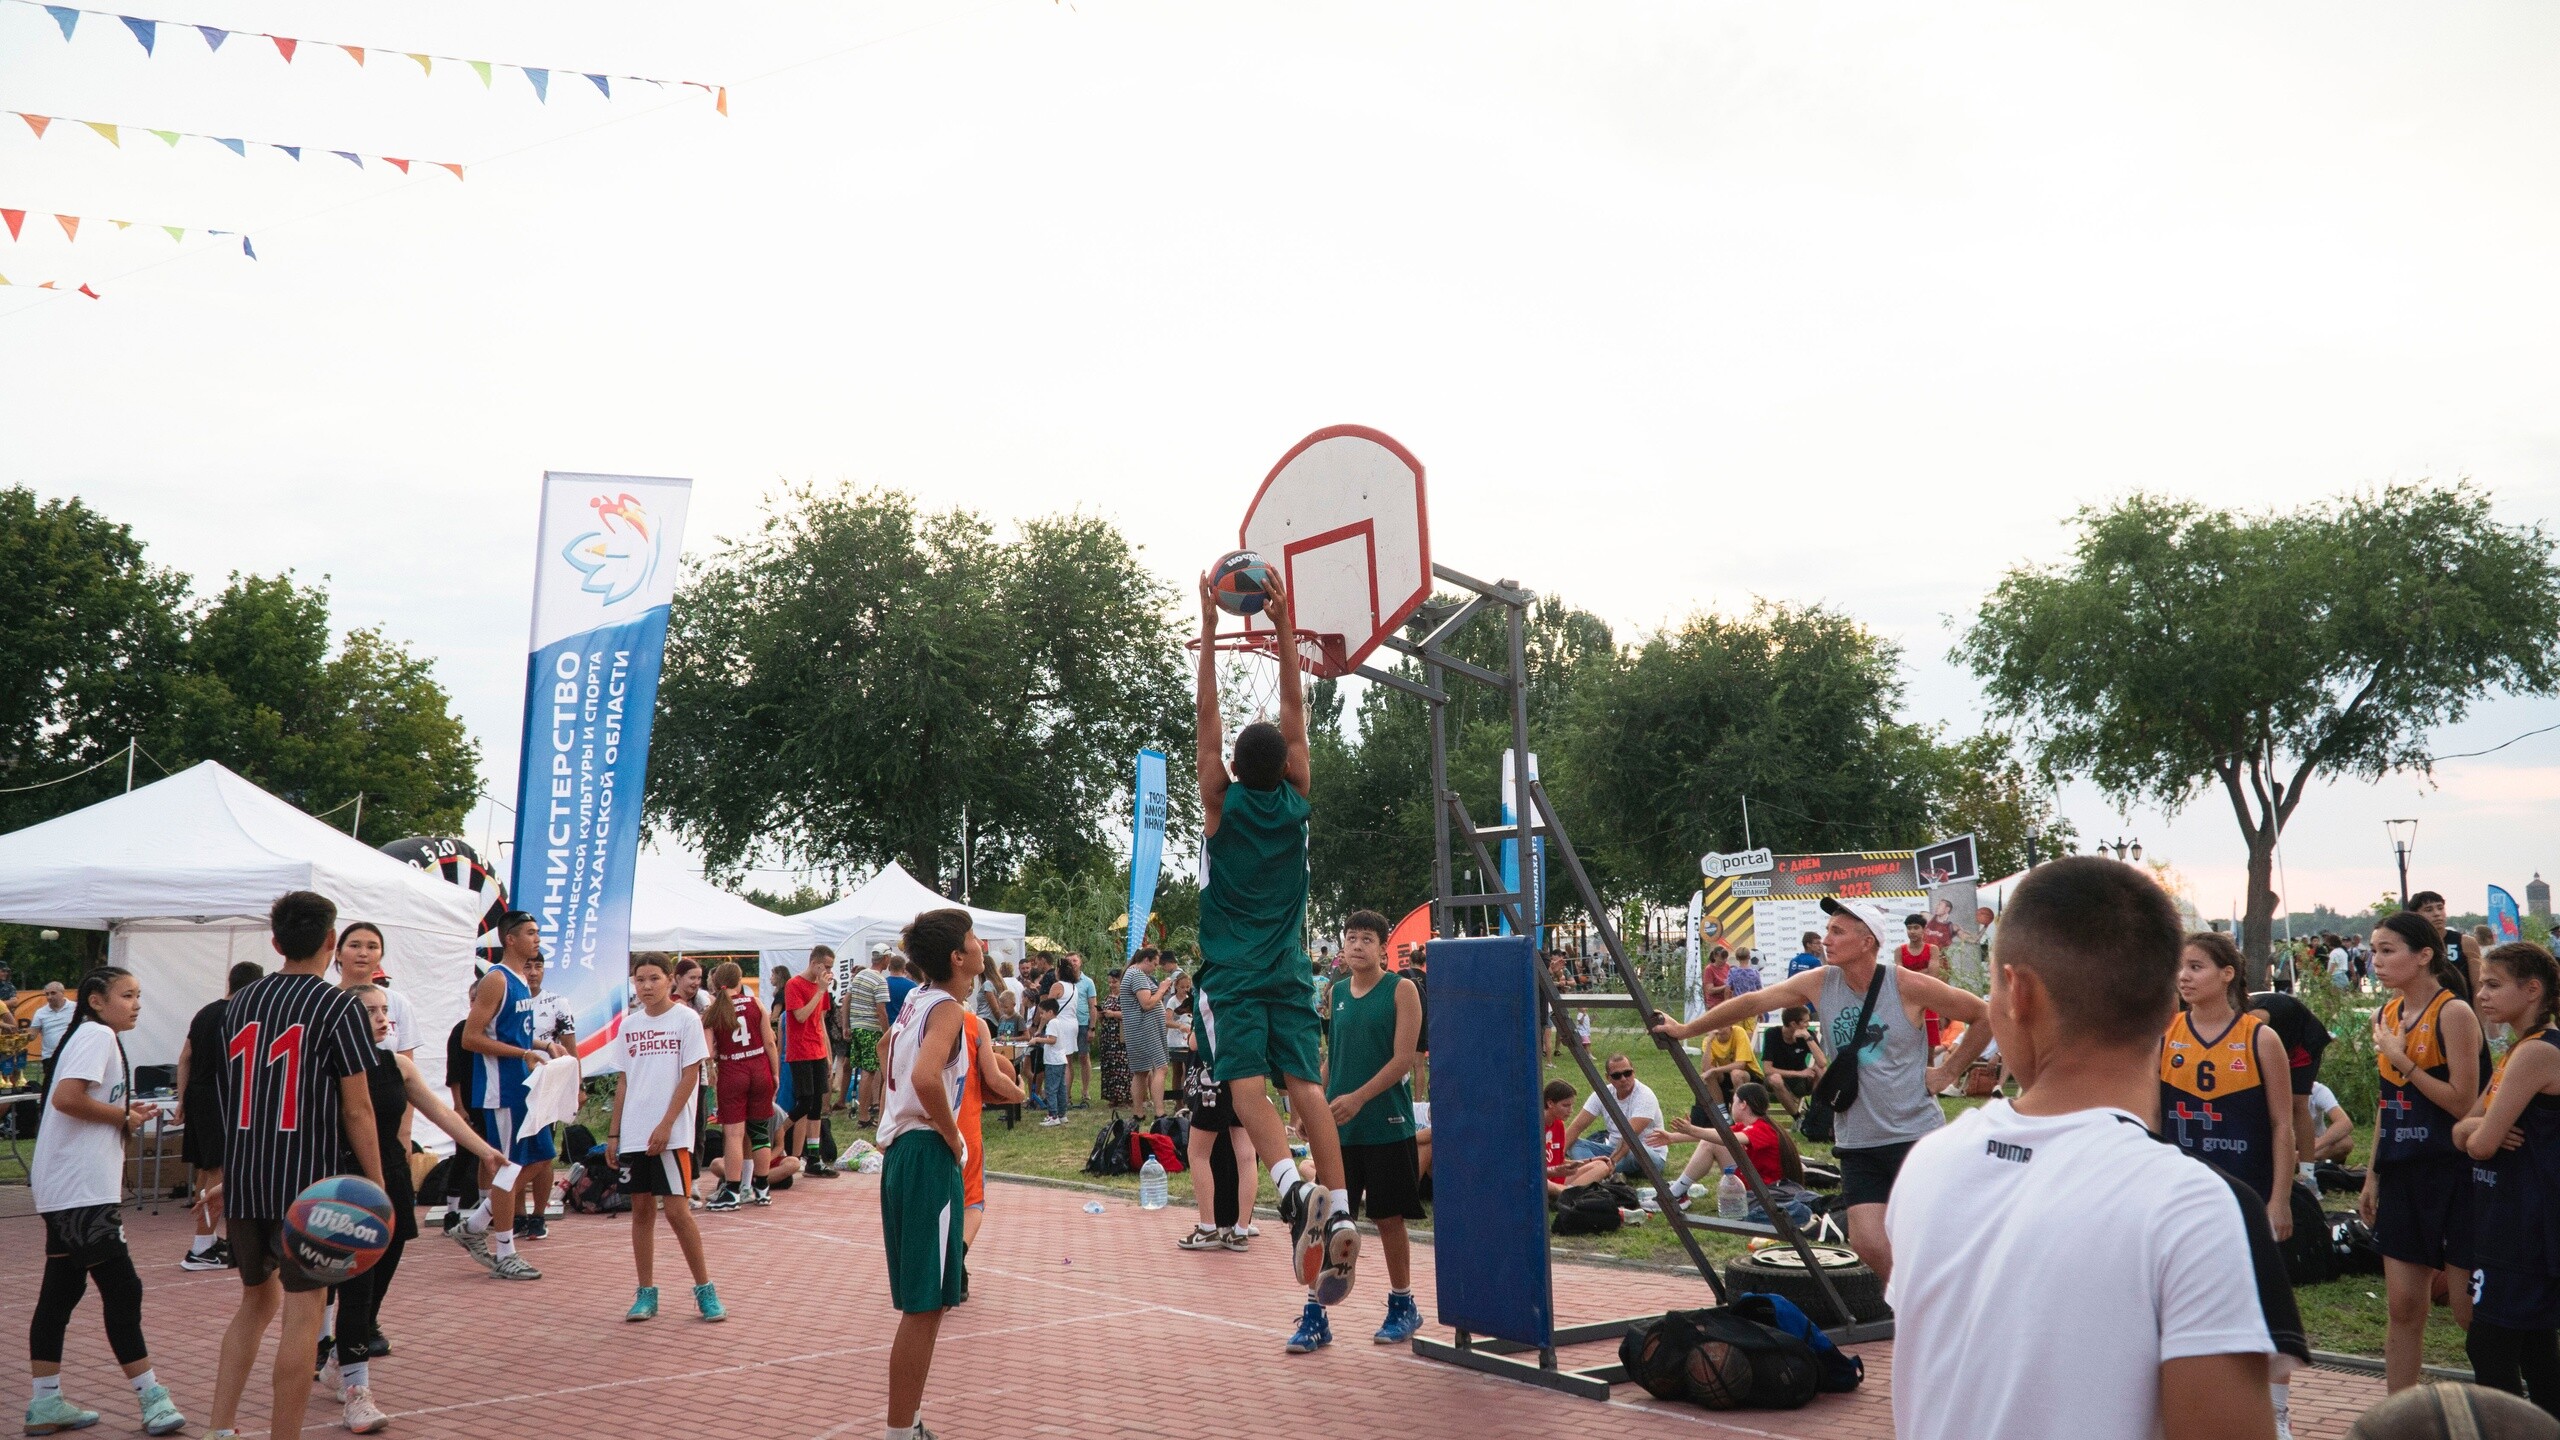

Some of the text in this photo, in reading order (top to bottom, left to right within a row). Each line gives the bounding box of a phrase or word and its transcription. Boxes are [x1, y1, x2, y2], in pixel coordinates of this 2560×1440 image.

[540, 651, 581, 969] МИНИСТЕРСТВО
[562, 651, 602, 969] ФИЗИЧЕСКОЙ КУЛЬТУРЫ И СПОРТА
[580, 651, 630, 970] АСТРАХАНСКОЙ ОБЛАСТИ
[420, 845, 436, 862] 5
[435, 840, 456, 857] 20
[1723, 852, 1768, 872] portal
[1790, 857, 1821, 873] ДНЁМ
[1732, 879, 1771, 888] РЕКЛАМНАЯ
[1795, 862, 1900, 885] ФИЗКУЛЬТУРНИКА!
[1733, 889, 1768, 897] КОМПАНИЯ
[1839, 881, 1871, 898] 2023
[2447, 944, 2458, 961] 5
[732, 1016, 751, 1046] 4
[230, 1021, 304, 1131] 11
[2197, 1060, 2215, 1092] 6
[1986, 1140, 2032, 1163] PUMA
[2203, 1138, 2247, 1153] group
[619, 1168, 631, 1184] 3
[308, 1205, 378, 1243] Wilson
